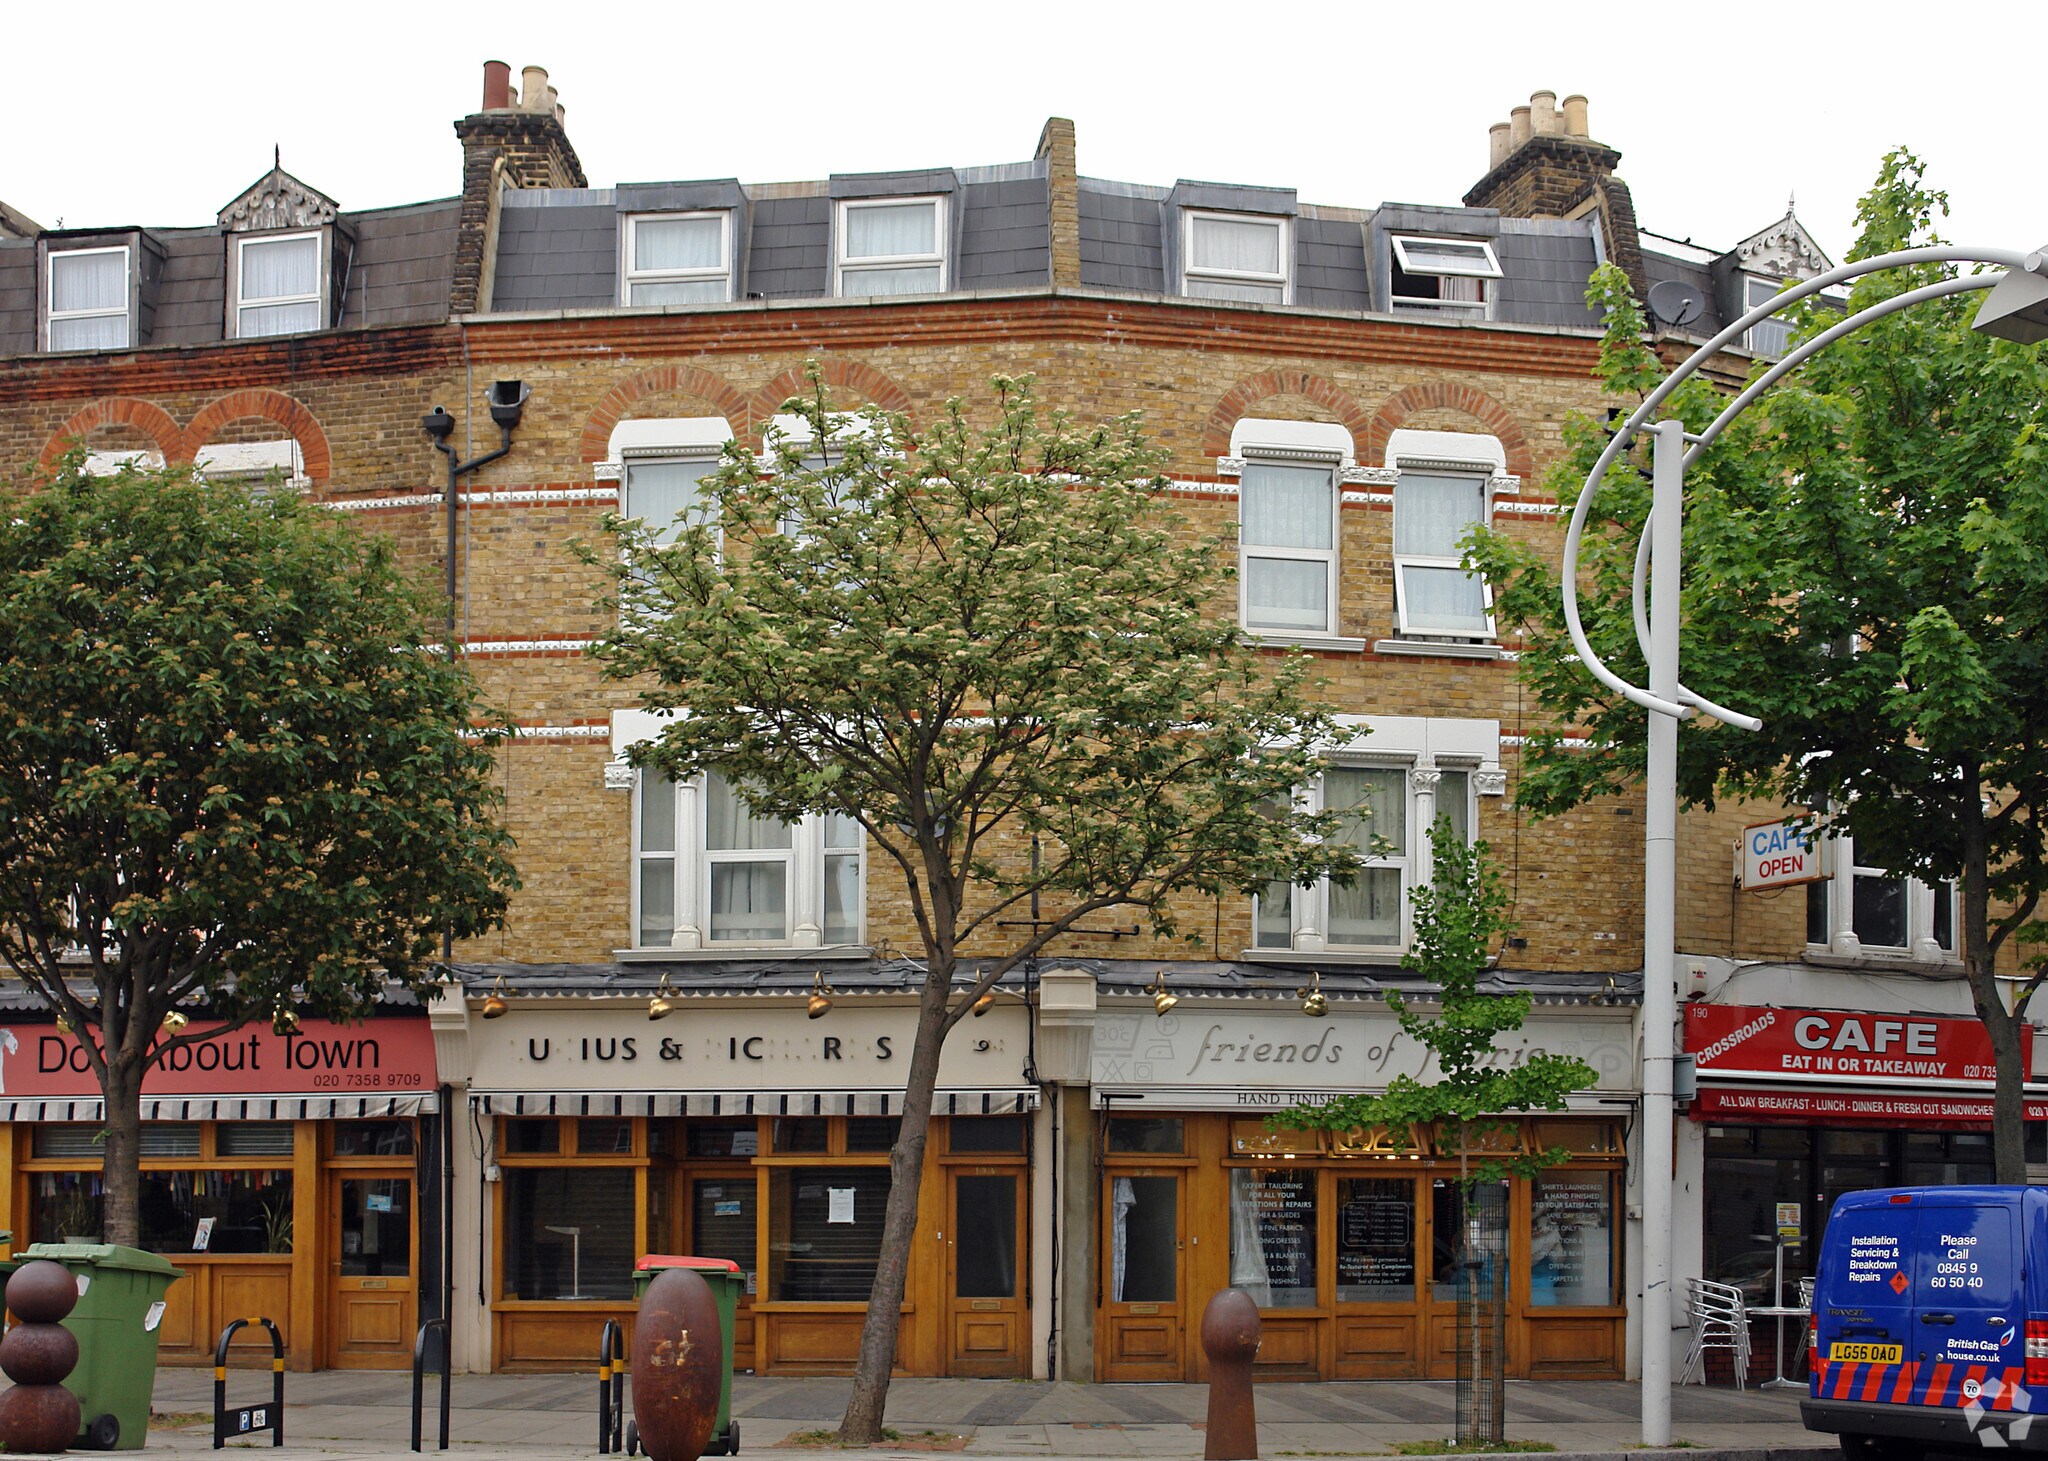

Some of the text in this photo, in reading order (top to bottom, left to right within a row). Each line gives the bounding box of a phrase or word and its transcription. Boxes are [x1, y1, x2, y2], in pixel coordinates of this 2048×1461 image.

[1753, 826, 1809, 855] CAFE
[1759, 855, 1803, 878] OPEN
[1692, 1008, 1708, 1019] 190
[1696, 1011, 1776, 1065] CROSSROADS
[1794, 1016, 1937, 1055] CAFE
[39, 1035, 106, 1074] Do
[275, 1032, 379, 1070] Town
[659, 1037, 683, 1060] &
[1187, 1025, 1343, 1076] friends
[1367, 1032, 1403, 1073] of
[1782, 1054, 1947, 1075] EAT IN OR TAKEAWAY
[1963, 1065, 1996, 1079] 020 735
[313, 1074, 421, 1086] 020 7358 9709
[1237, 1093, 1356, 1105] HAND FINISH
[1719, 1095, 1737, 1107] ALL
[1738, 1096, 1757, 1108] DAY
[1758, 1097, 1810, 1110] BREAKFAST
[1816, 1099, 1846, 1111] LUNCH
[1852, 1101, 1884, 1112] DINNER
[1886, 1102, 1893, 1113] &
[1894, 1103, 1922, 1114] FRESH
[1922, 1103, 1939, 1115] CUT
[1941, 1104, 1994, 1116] SANDWICHES
[2028, 1106, 2043, 1117] 020
[1851, 1236, 1898, 1246] Installation
[1940, 1235, 1977, 1246] Please
[1851, 1247, 1900, 1259] Servicing &
[1948, 1249, 1969, 1260] Call
[1850, 1260, 1897, 1269] Breakdown
[1937, 1262, 1978, 1274] 0845 9
[1849, 1272, 1881, 1283] Repairs
[1931, 1277, 1983, 1288] 60 50 40
[1947, 1338, 1999, 1351] British Gas
[1836, 1345, 1868, 1360] LG56
[1947, 1350, 2000, 1362] house.co.uk
[1966, 1385, 1978, 1393] 70
[241, 1413, 248, 1429] P
